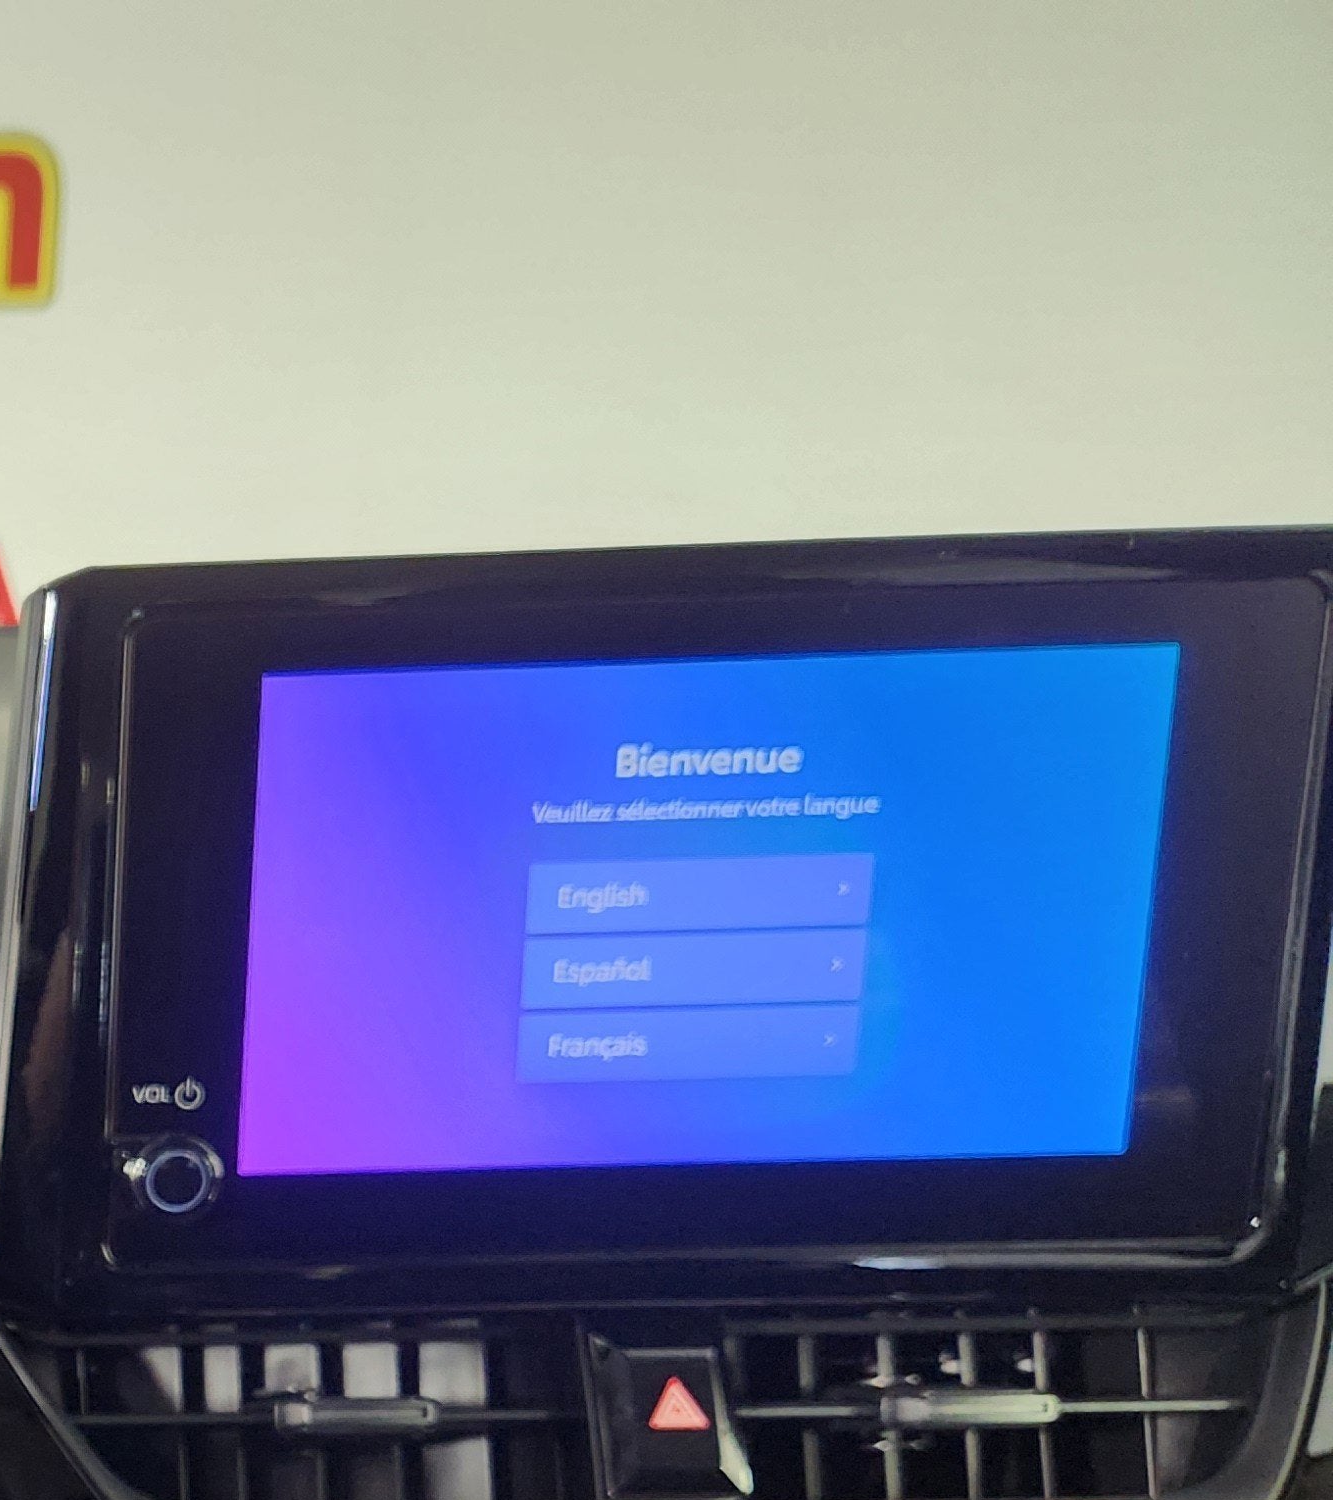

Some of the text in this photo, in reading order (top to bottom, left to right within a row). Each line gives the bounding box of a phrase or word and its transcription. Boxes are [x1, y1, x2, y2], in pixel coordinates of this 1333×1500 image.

[615, 743, 805, 779] Bienvenue
[532, 799, 614, 825] Veuillez
[744, 797, 800, 818] votre
[803, 793, 882, 820] langue
[556, 880, 650, 913] English
[552, 955, 653, 986] Español
[132, 1083, 171, 1104] VOL
